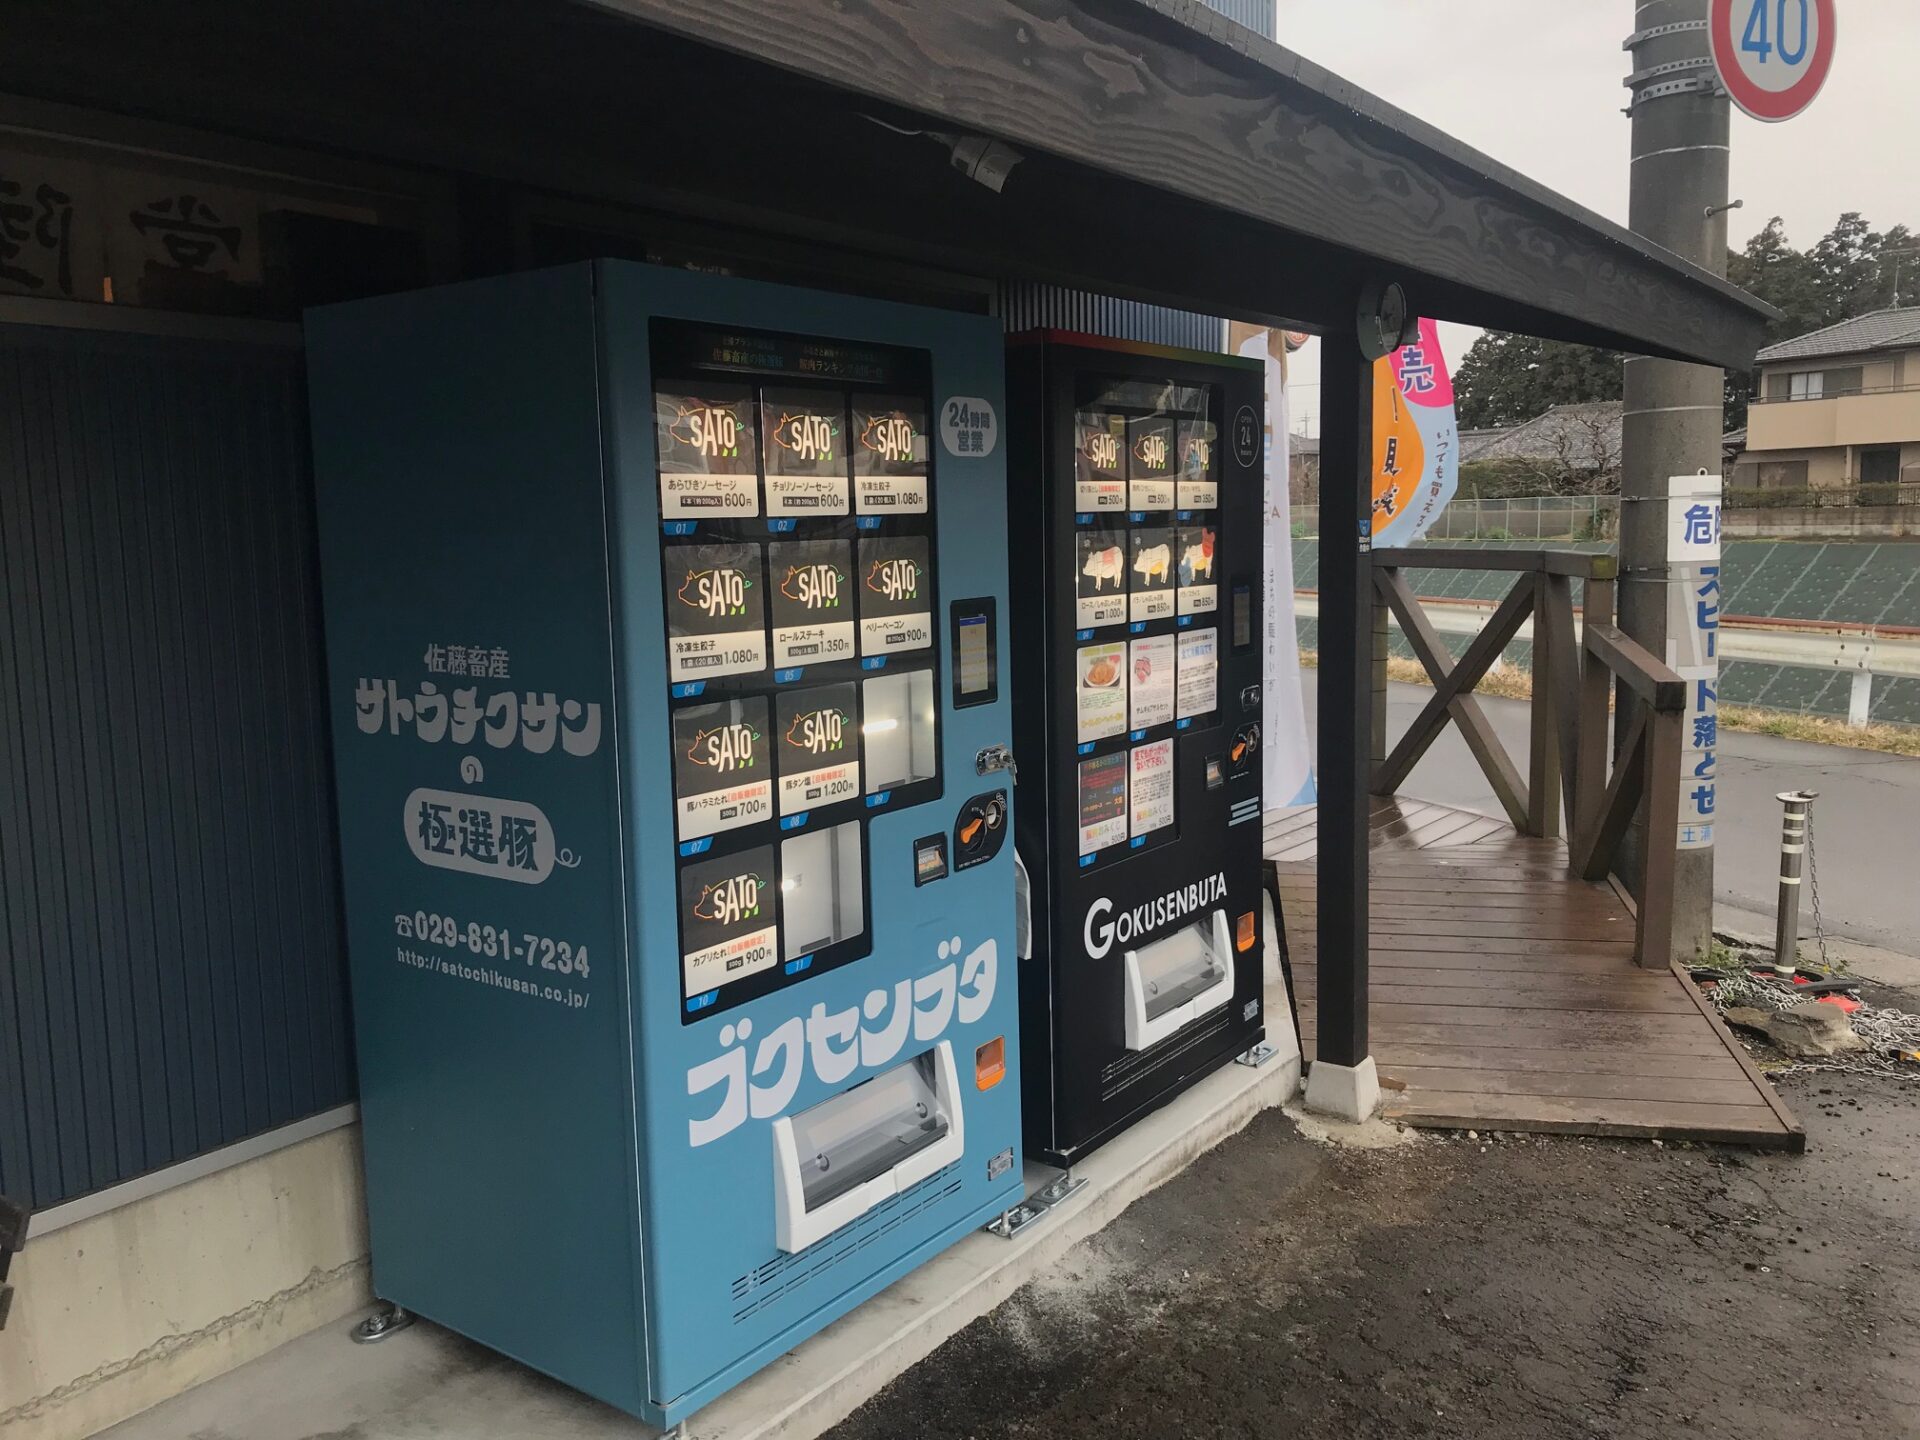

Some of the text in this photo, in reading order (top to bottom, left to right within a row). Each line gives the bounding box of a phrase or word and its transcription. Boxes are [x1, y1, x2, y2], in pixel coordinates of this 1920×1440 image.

[1741, 0, 1808, 65] 40
[1400, 347, 1434, 392] 売
[949, 402, 990, 429] 24時間
[691, 409, 736, 456] SATO
[792, 416, 832, 459] SATO
[877, 419, 913, 459] SATO
[958, 430, 984, 452] 営業
[1241, 426, 1251, 446] 24
[1092, 433, 1117, 468] SATO
[1143, 436, 1167, 468] SATO
[668, 480, 737, 491] あらびきソーセージ
[772, 482, 835, 491] チョリソーソーセージ
[861, 482, 891, 491] 冷凍生餃子
[724, 493, 752, 507] 600円
[820, 494, 845, 507] 600円
[676, 523, 687, 534] 01
[778, 522, 788, 533] 02
[866, 518, 875, 528] 03
[799, 565, 837, 609] SATO
[882, 559, 915, 600] SATO
[699, 569, 744, 616] SATO
[779, 630, 825, 643] ロールステーキ
[906, 628, 927, 642] 900円
[676, 640, 716, 653] 冷凍生餃子
[424, 643, 511, 679] 佐藤畜産
[870, 658, 880, 668] 06
[784, 671, 794, 681] 05
[685, 684, 696, 695] 04
[355, 677, 602, 757] サトウチクサン
[803, 709, 842, 755] SATO
[708, 724, 752, 773] SATO
[460, 755, 484, 784] の
[786, 776, 811, 790] 豚タン塩
[687, 794, 728, 813] 豚ハラミたれ
[739, 800, 767, 817] 700円
[790, 816, 800, 827] 08
[419, 801, 540, 873] 極選豚
[691, 840, 702, 852] 07
[714, 874, 757, 925] SATO
[1084, 871, 1227, 960] GOKUSENBUTA
[415, 910, 590, 979] 029-831-7234
[746, 947, 772, 964] 900円
[796, 959, 804, 970] 11
[397, 946, 590, 1009] http://satochikusan.co.jp/
[699, 994, 710, 1006] 10
[687, 936, 998, 1148] ゴクセンブタ
